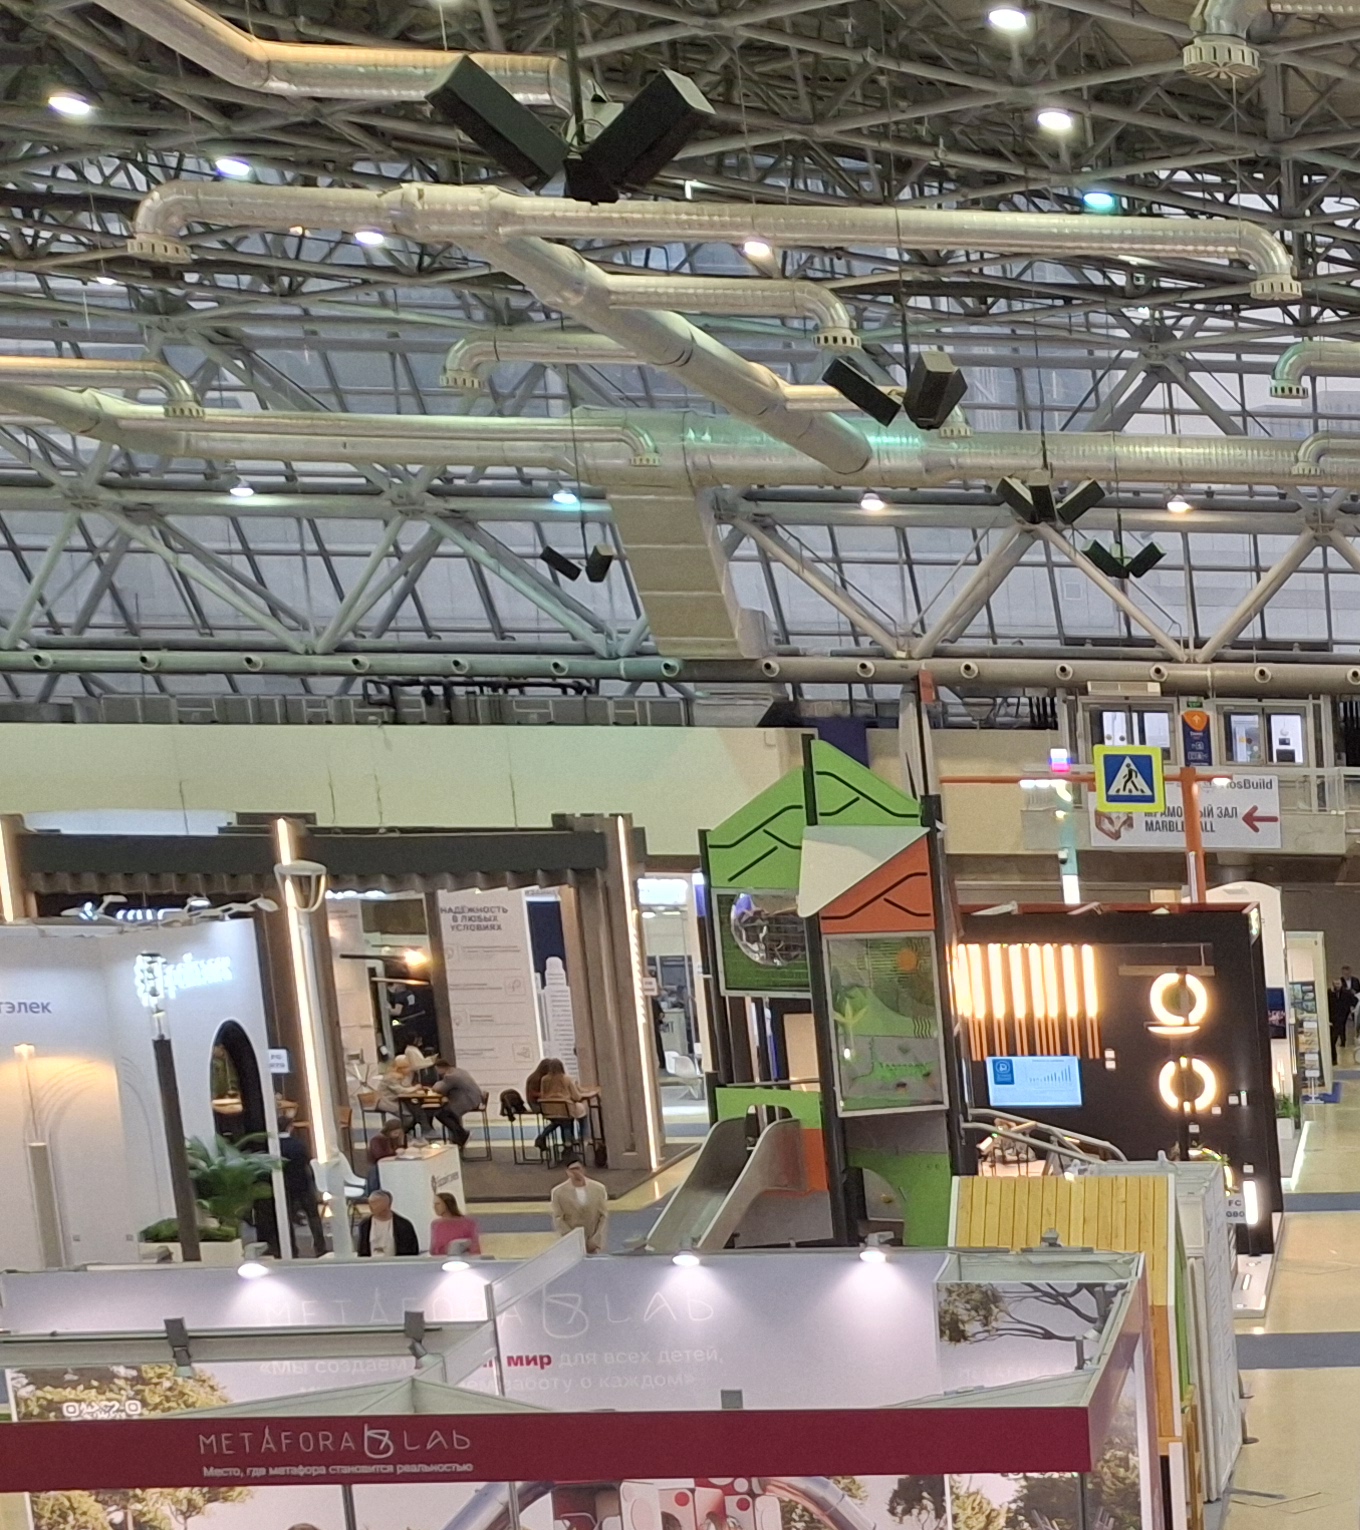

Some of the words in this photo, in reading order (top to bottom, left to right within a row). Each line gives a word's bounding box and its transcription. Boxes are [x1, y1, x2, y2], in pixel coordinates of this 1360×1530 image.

[1217, 778, 1273, 790] osBuild
[1144, 806, 1214, 818] МРАМОЫЙ
[1217, 806, 1238, 819] ЗАЛ
[0, 1001, 52, 1014] элек
[506, 1353, 552, 1370] мир
